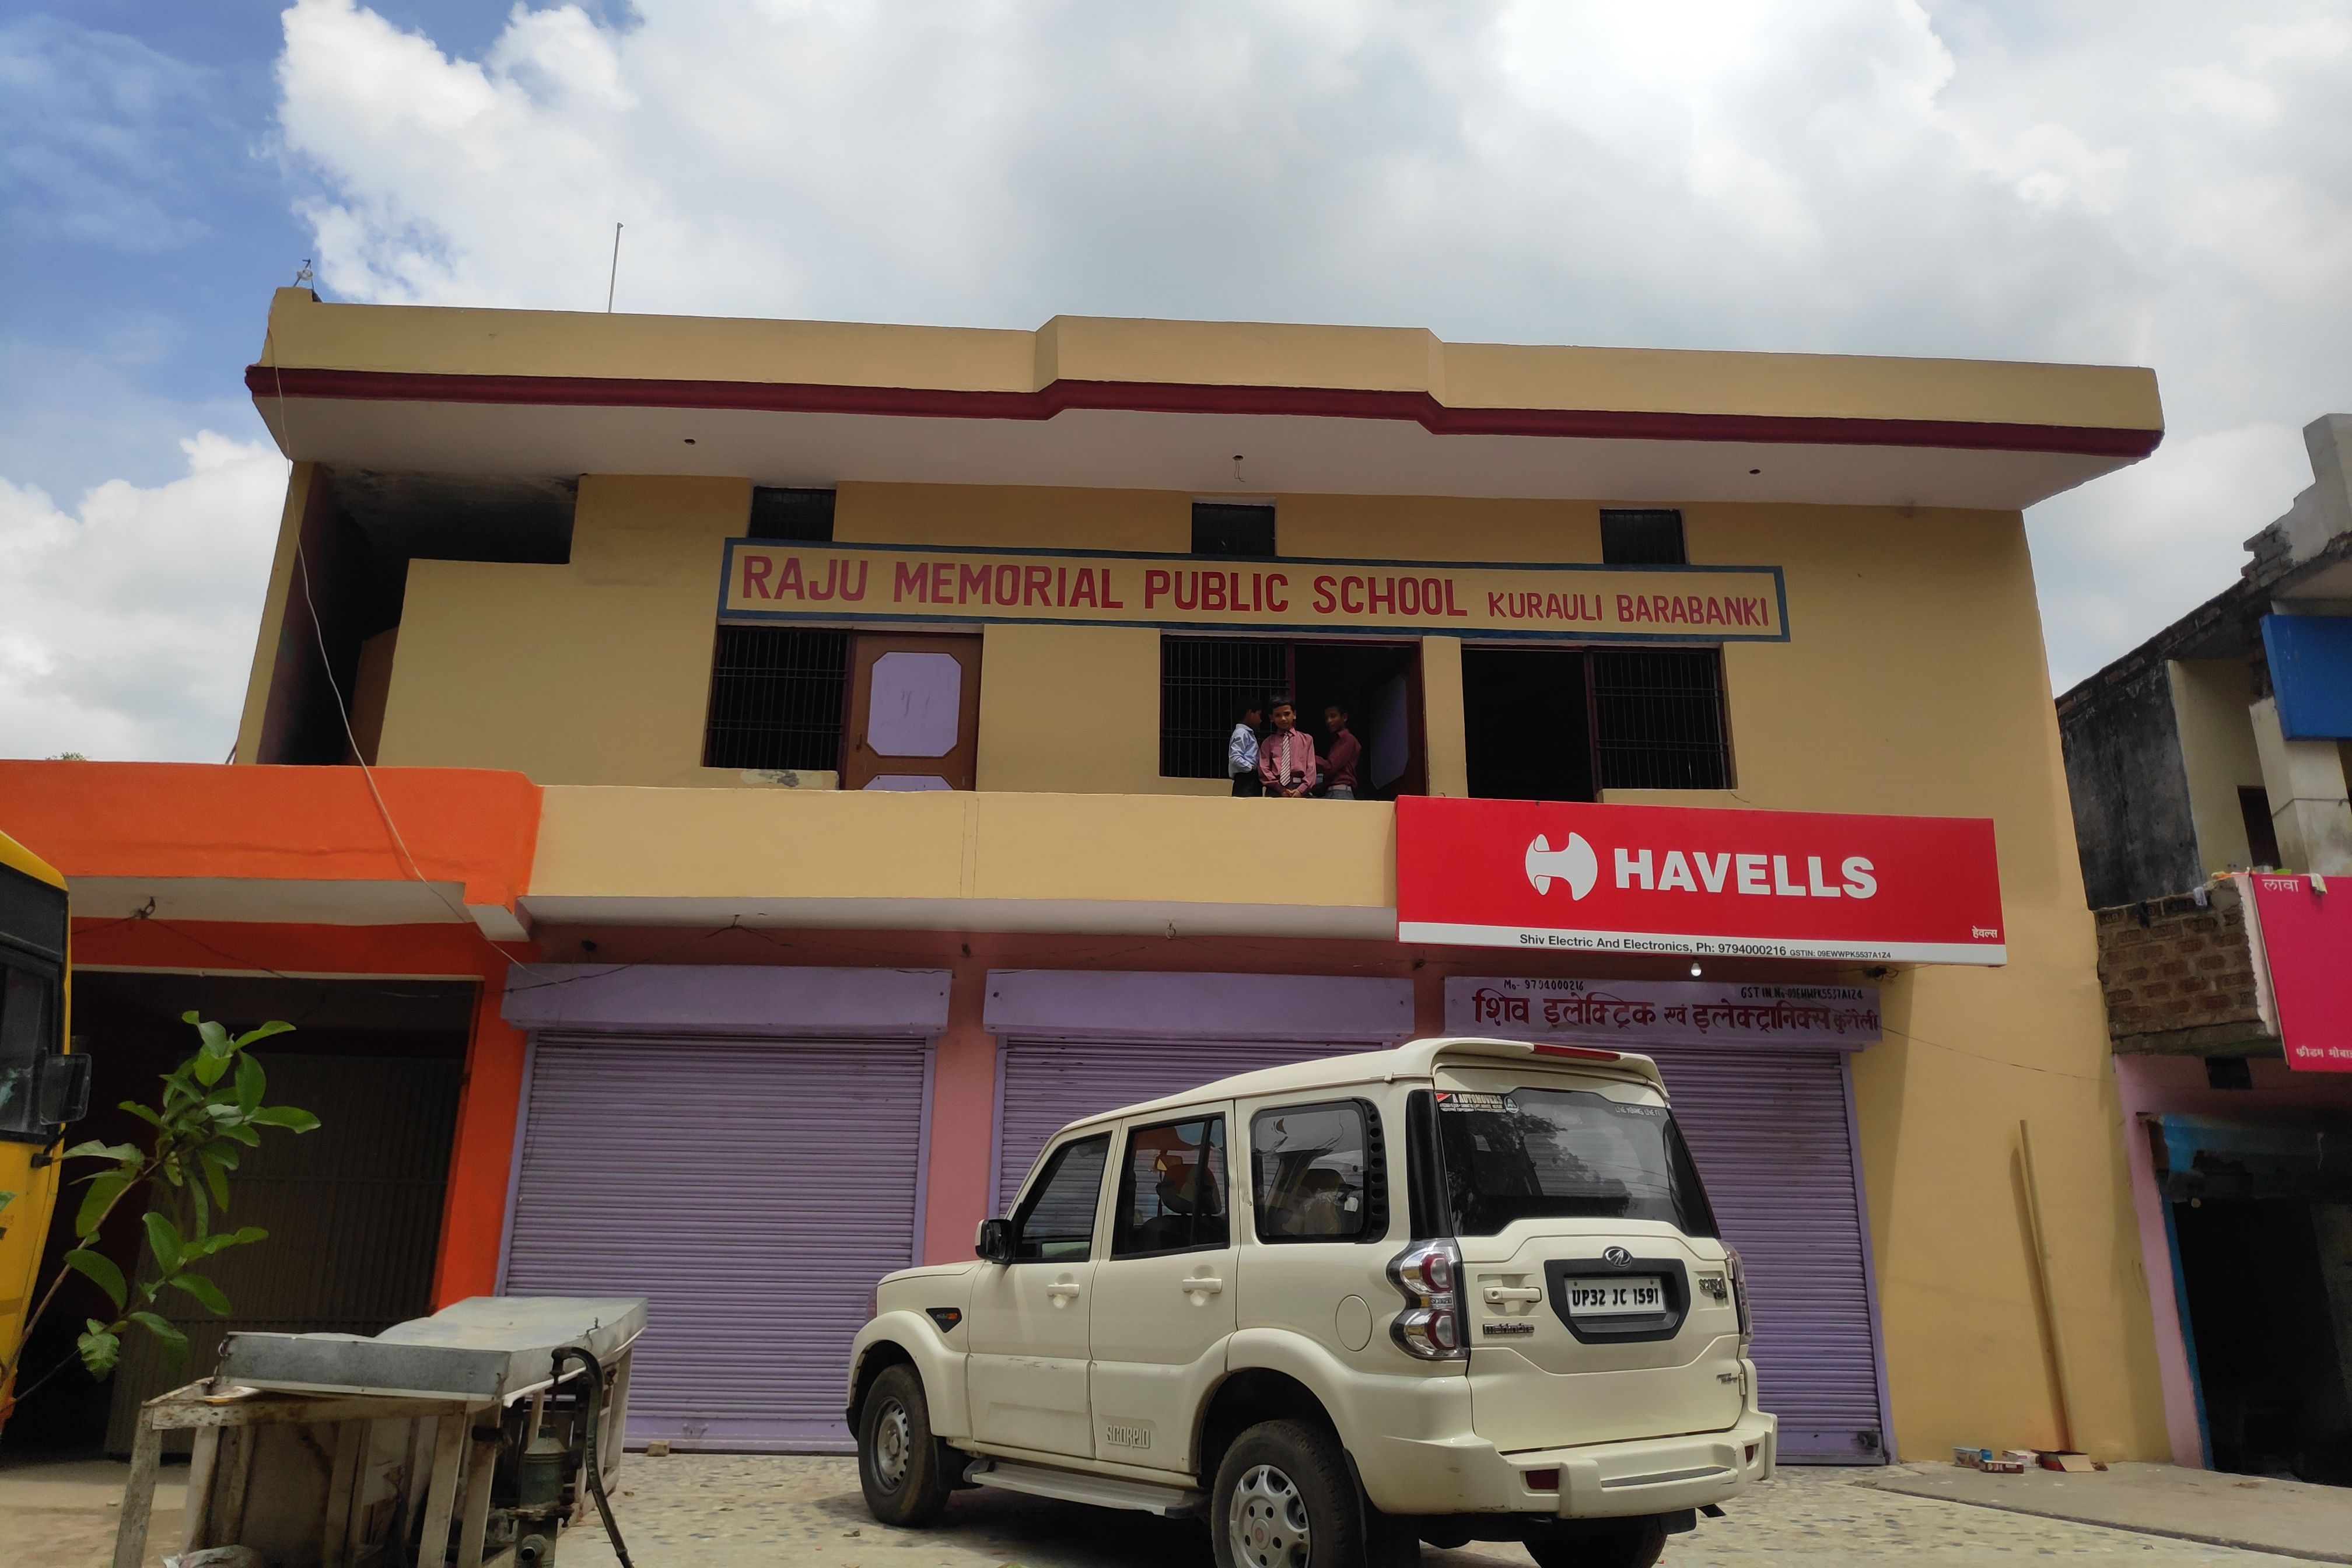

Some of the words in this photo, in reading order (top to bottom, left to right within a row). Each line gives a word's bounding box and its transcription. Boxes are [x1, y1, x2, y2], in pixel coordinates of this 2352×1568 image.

[742, 555, 869, 603] RAJU
[893, 561, 1124, 610] MEMORIAL
[1143, 569, 1289, 612] PUBLIC
[1312, 575, 1468, 617] SCHOOL
[1488, 591, 1603, 622] KURAULI
[1616, 594, 1769, 627] BARABANKI
[1614, 848, 1878, 900] HAVELLS
[2262, 878, 2299, 892] लावा
[1519, 934, 1545, 945] Shiv
[1548, 935, 1594, 947] Electric
[1596, 938, 1620, 949] And
[1623, 939, 1693, 954] Electronics,
[1696, 942, 1716, 953] Ph:
[1718, 943, 1787, 957] 9794000216
[1789, 948, 1815, 957] GSTIN:
[1472, 988, 1531, 1027] शिव
[1572, 1289, 1606, 1307] UP32
[1612, 1288, 1627, 1305] JC
[1633, 1287, 1659, 1305] 1591
